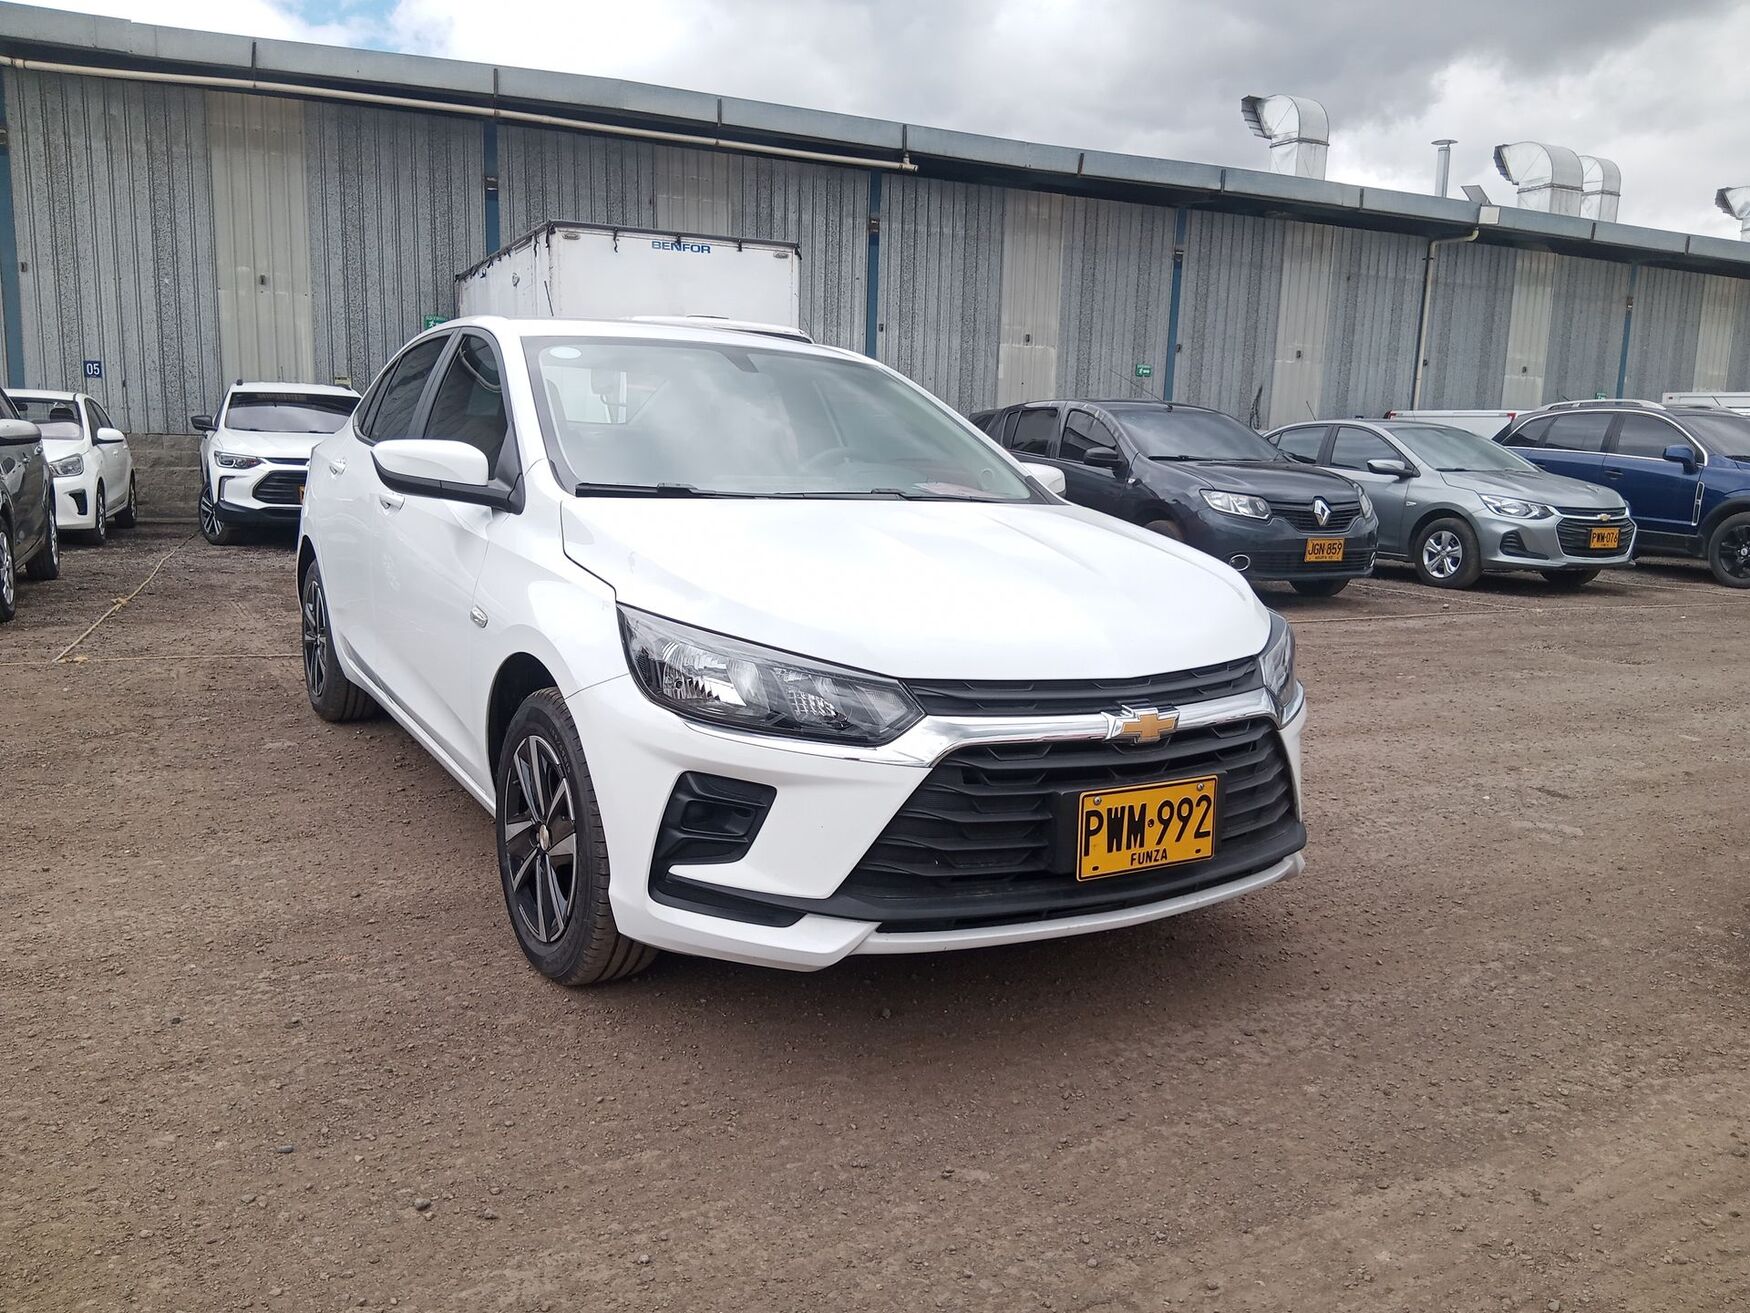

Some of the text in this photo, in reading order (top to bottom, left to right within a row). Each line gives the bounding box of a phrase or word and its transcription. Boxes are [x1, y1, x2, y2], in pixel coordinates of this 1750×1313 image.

[651, 241, 711, 254] BENFOR
[86, 363, 100, 375] 05
[1130, 848, 1168, 866] FUNZA
